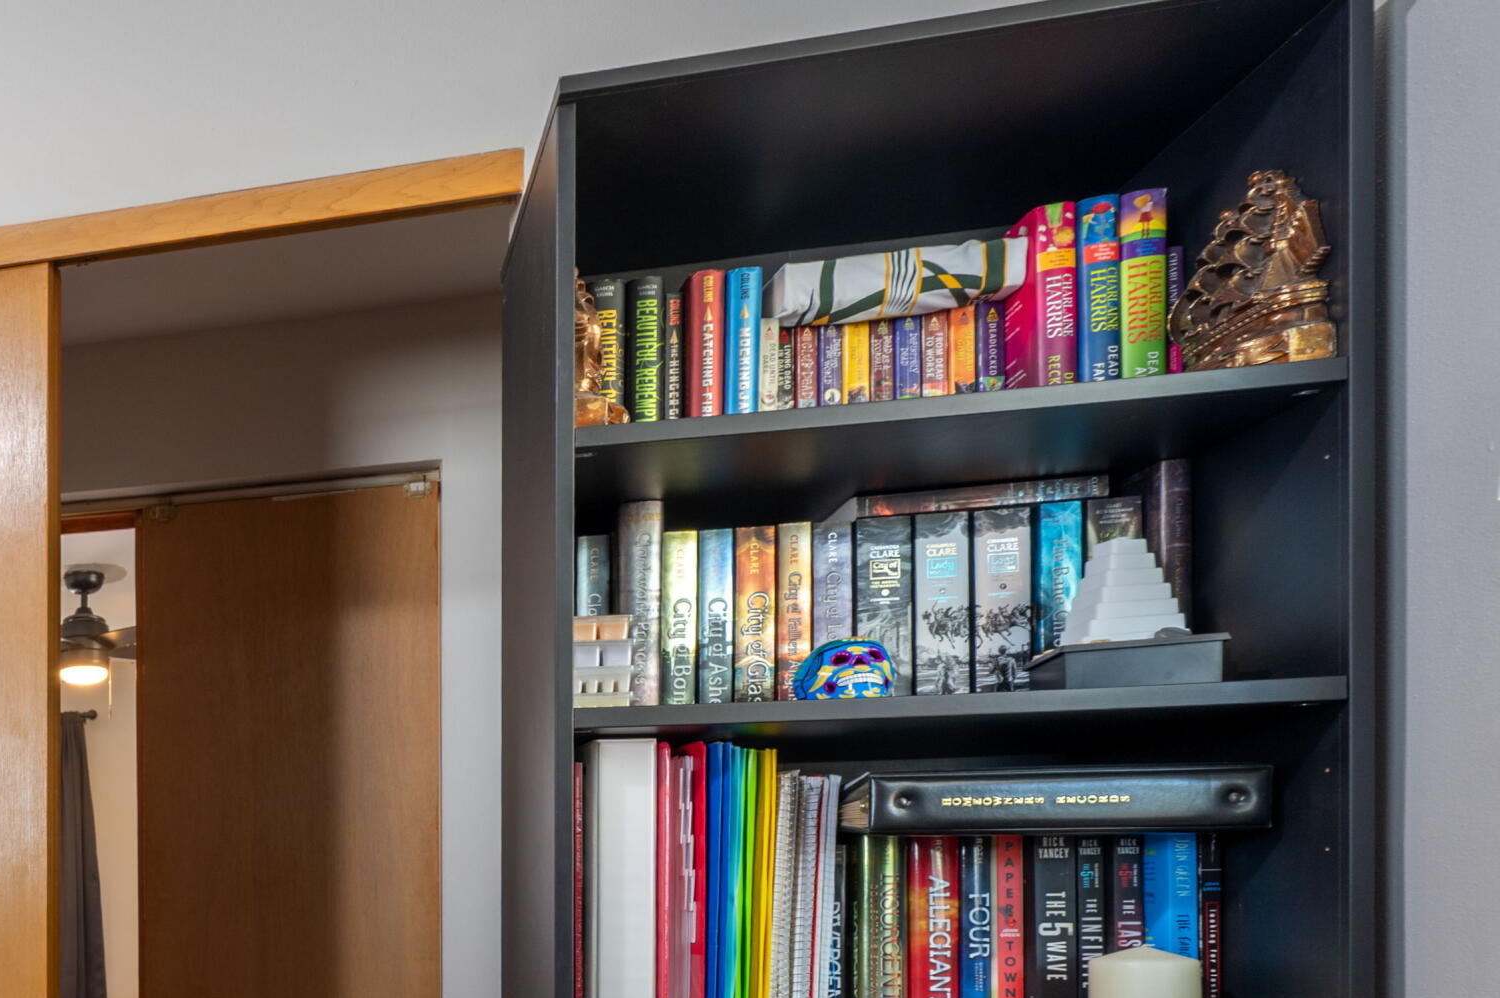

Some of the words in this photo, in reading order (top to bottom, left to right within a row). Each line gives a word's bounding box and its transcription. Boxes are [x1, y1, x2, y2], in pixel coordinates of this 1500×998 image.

[703, 276, 713, 303] COLLINS
[740, 273, 750, 300] COLLINS
[1090, 269, 1107, 333] HARRIS
[1108, 267, 1118, 332] CHARLAINE
[1149, 259, 1164, 343] CHARLAINE
[1045, 275, 1063, 339] HARRIS
[1062, 273, 1074, 337] CHARLAINE
[1128, 261, 1150, 344] HARRIS
[635, 299, 658, 365] BEAUTIFUL
[926, 336, 934, 347] TO
[935, 332, 943, 355] FROM
[702, 323, 714, 387] CATCHING
[926, 348, 934, 378] WORSE
[988, 322, 998, 376] DEADLOCKED
[1108, 345, 1119, 376] DEAD
[669, 360, 680, 408] HUNGER
[935, 358, 943, 380] DEAD
[750, 542, 759, 575] CLARE
[789, 534, 798, 564] CLARE
[828, 532, 838, 563] CLARE
[869, 550, 900, 559] CLARE
[926, 548, 957, 557] CLARE
[987, 542, 1019, 552] CLARE
[1054, 538, 1068, 562] The
[590, 547, 598, 581] CLARE
[636, 532, 650, 615] Clockwork
[784, 571, 802, 600] City
[820, 570, 841, 603] City
[1053, 566, 1069, 605] Bane
[669, 598, 692, 640] City
[704, 598, 728, 641] City
[742, 591, 770, 636] City
[787, 602, 800, 614] of
[825, 604, 840, 617] of
[677, 643, 691, 658] of
[712, 643, 728, 657] of
[747, 640, 766, 659] of
[788, 616, 801, 656] Fallen
[634, 622, 650, 687] Princess
[941, 796, 1045, 807] HOMEOWNERS
[1055, 795, 1130, 804] RECORDS
[1038, 848, 1070, 859] YANCEY
[1042, 837, 1065, 847] RICK
[1177, 864, 1191, 897] GREEN
[1045, 891, 1067, 917] THE
[1086, 899, 1097, 913] THE
[1122, 899, 1135, 915] THE
[881, 873, 901, 998] INSURGENT
[968, 893, 990, 959] FOUR
[1038, 922, 1074, 937] 5
[1176, 914, 1190, 930] THE
[1046, 941, 1068, 981] WAVE
